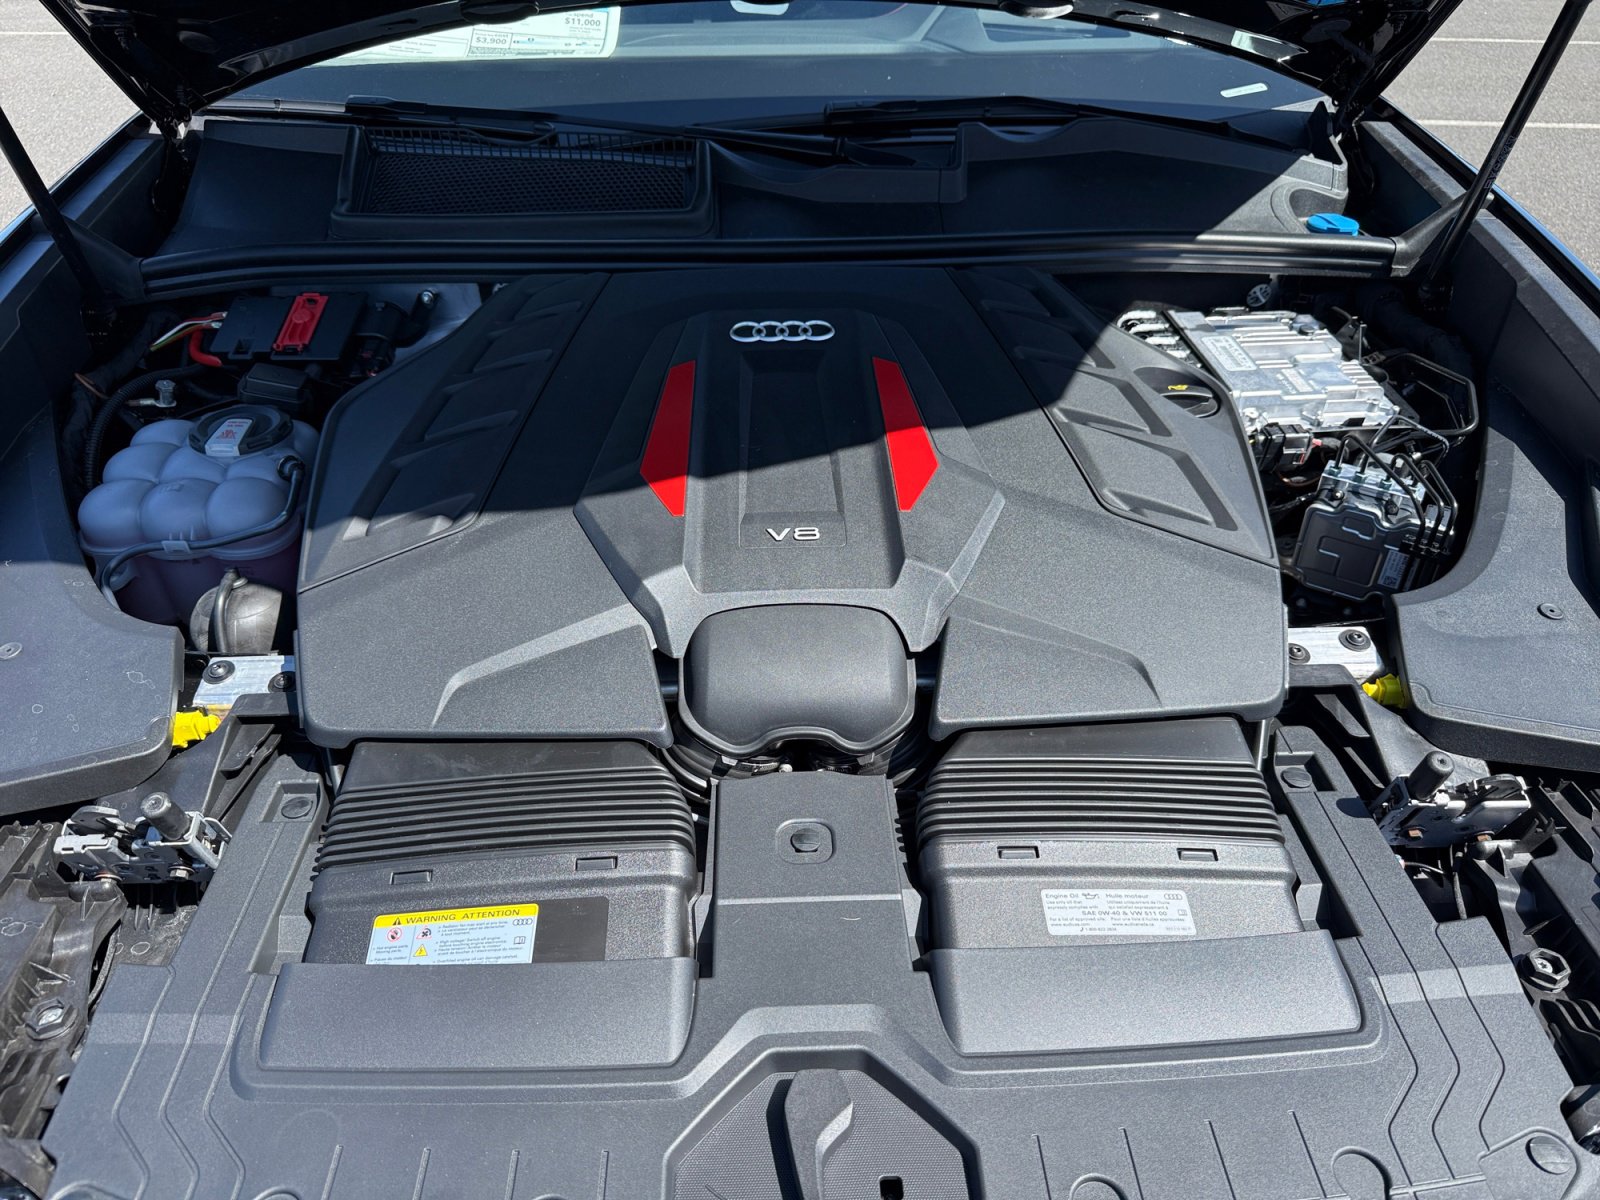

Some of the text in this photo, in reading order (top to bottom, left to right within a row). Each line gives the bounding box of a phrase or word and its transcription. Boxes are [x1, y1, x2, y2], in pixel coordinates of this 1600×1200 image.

[564, 17, 600, 26] $11,000
[476, 36, 507, 44] $3,900
[765, 527, 820, 541] V8
[405, 909, 520, 924] WARNING ATTENTION
